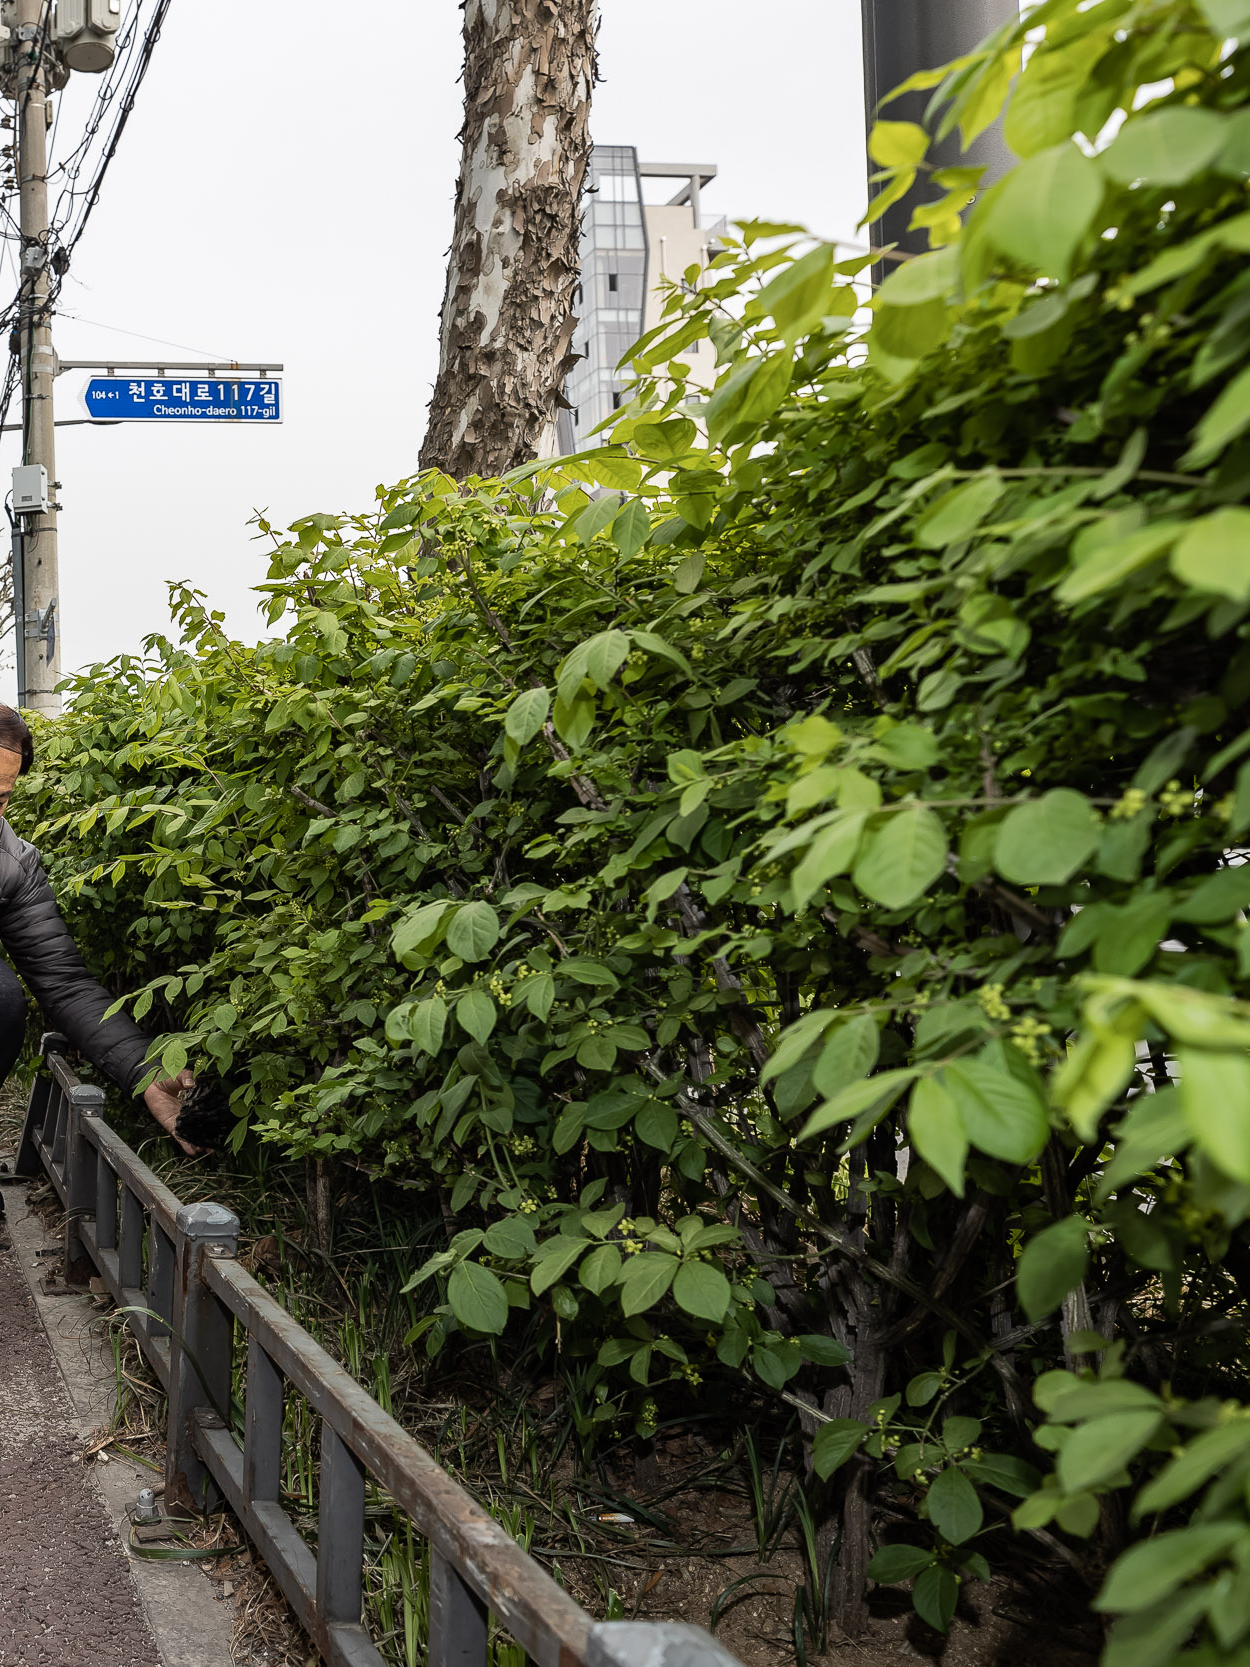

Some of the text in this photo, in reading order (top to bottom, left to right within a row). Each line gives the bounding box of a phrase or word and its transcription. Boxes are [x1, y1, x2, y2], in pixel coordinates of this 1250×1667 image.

[128, 381, 276, 404] 천호대로117길
[153, 405, 276, 418] Cheonho-daero 117-gil
